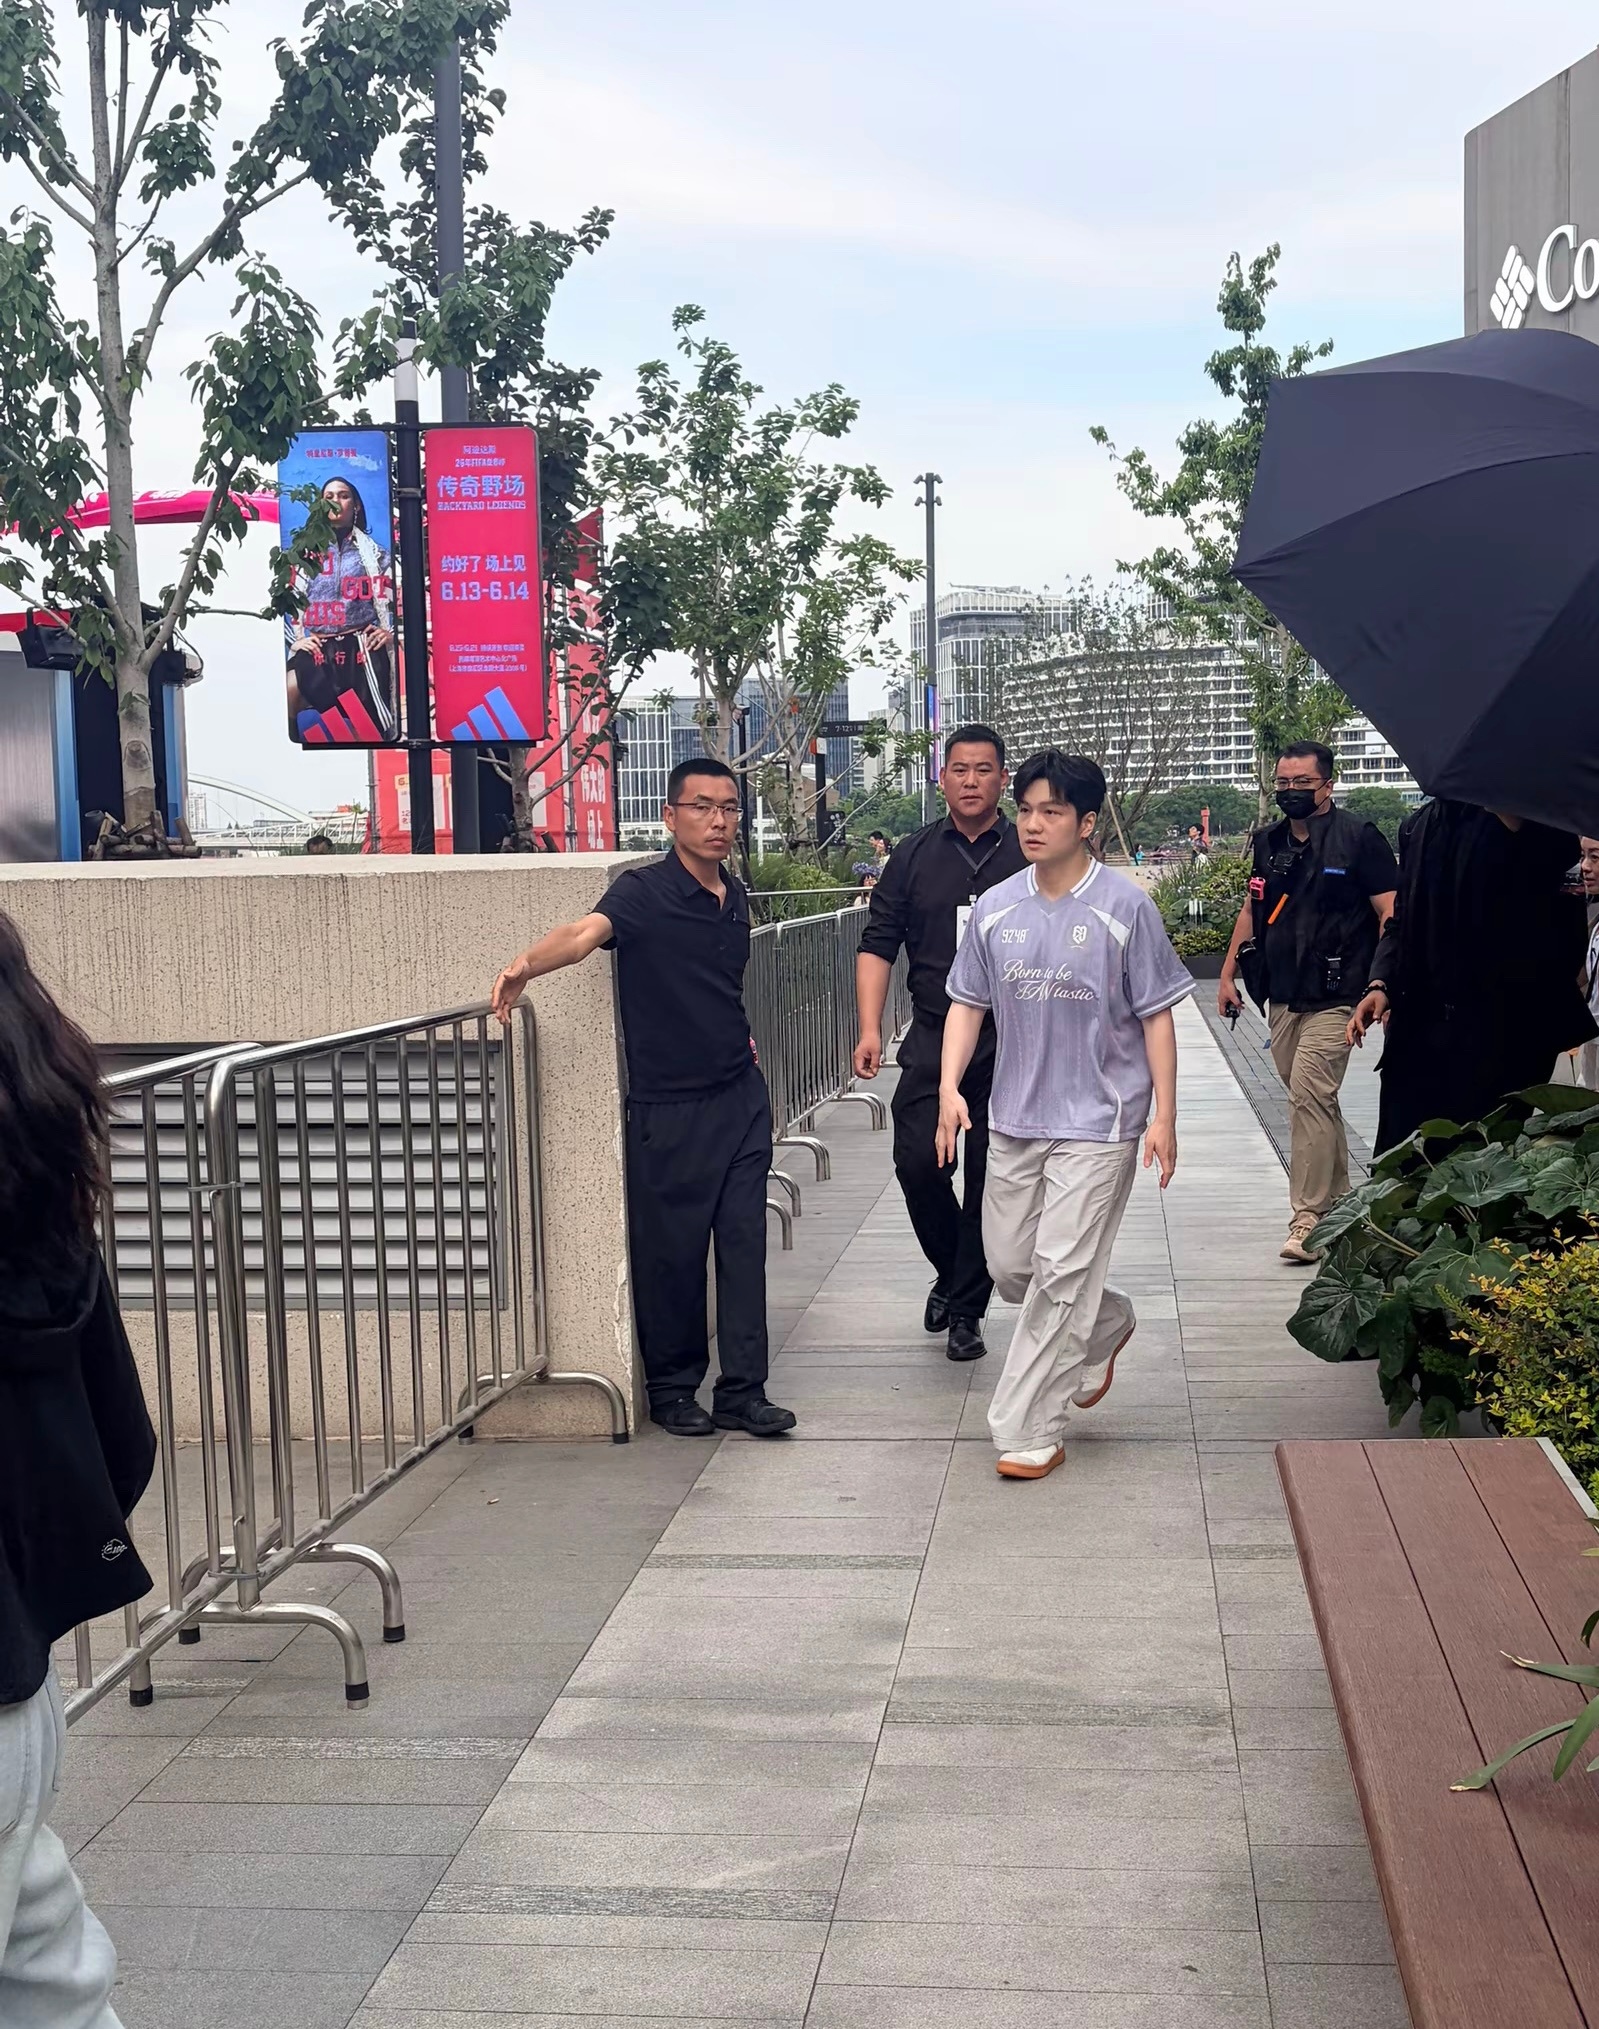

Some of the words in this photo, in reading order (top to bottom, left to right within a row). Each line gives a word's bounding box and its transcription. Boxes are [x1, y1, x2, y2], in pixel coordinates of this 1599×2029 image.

[437, 475, 525, 498] 传奇野场
[437, 501, 484, 510] BACKYARD
[441, 555, 481, 573] 约好了
[485, 554, 527, 573] 场上见
[341, 575, 391, 600] GOT
[441, 581, 529, 601] 6.13-6.14
[1001, 959, 1042, 982] Born
[1043, 967, 1053, 979] to
[1055, 963, 1073, 981] be
